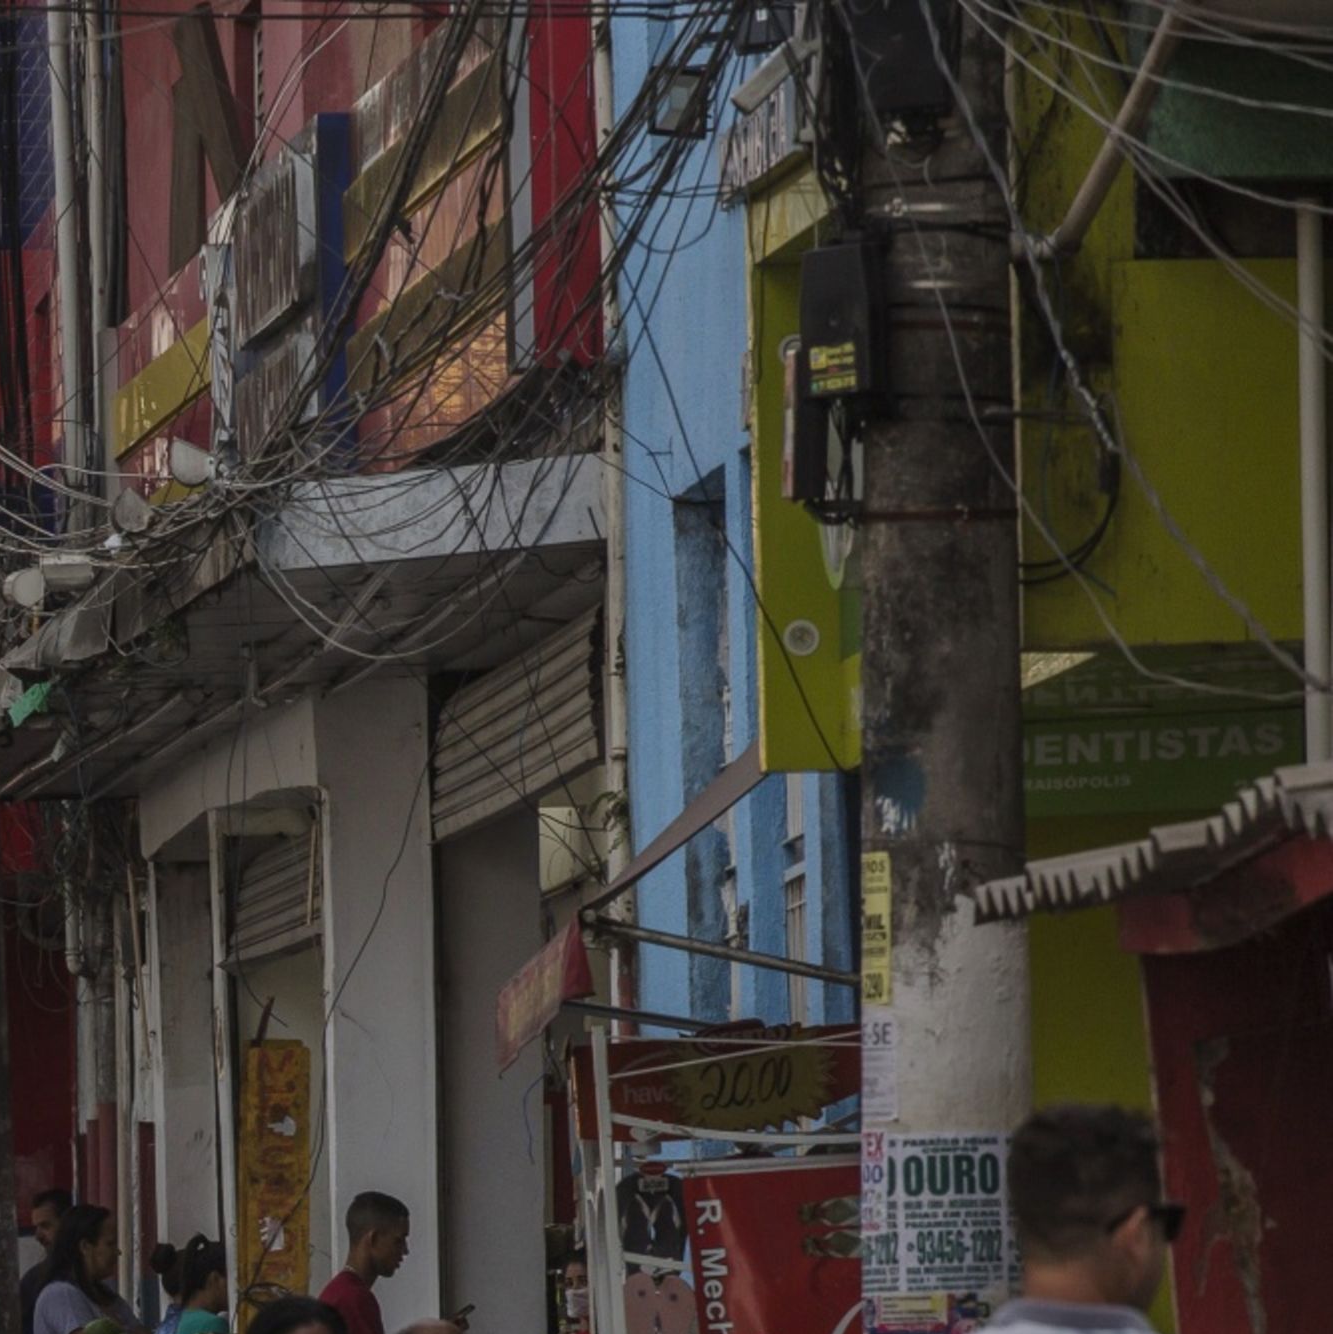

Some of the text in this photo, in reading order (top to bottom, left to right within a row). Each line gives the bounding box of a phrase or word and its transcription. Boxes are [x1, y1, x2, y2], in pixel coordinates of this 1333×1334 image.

[1023, 773, 1131, 791] RAISÓPOLIS
[902, 1152, 1000, 1197] OURO
[695, 1198, 723, 1235] R.
